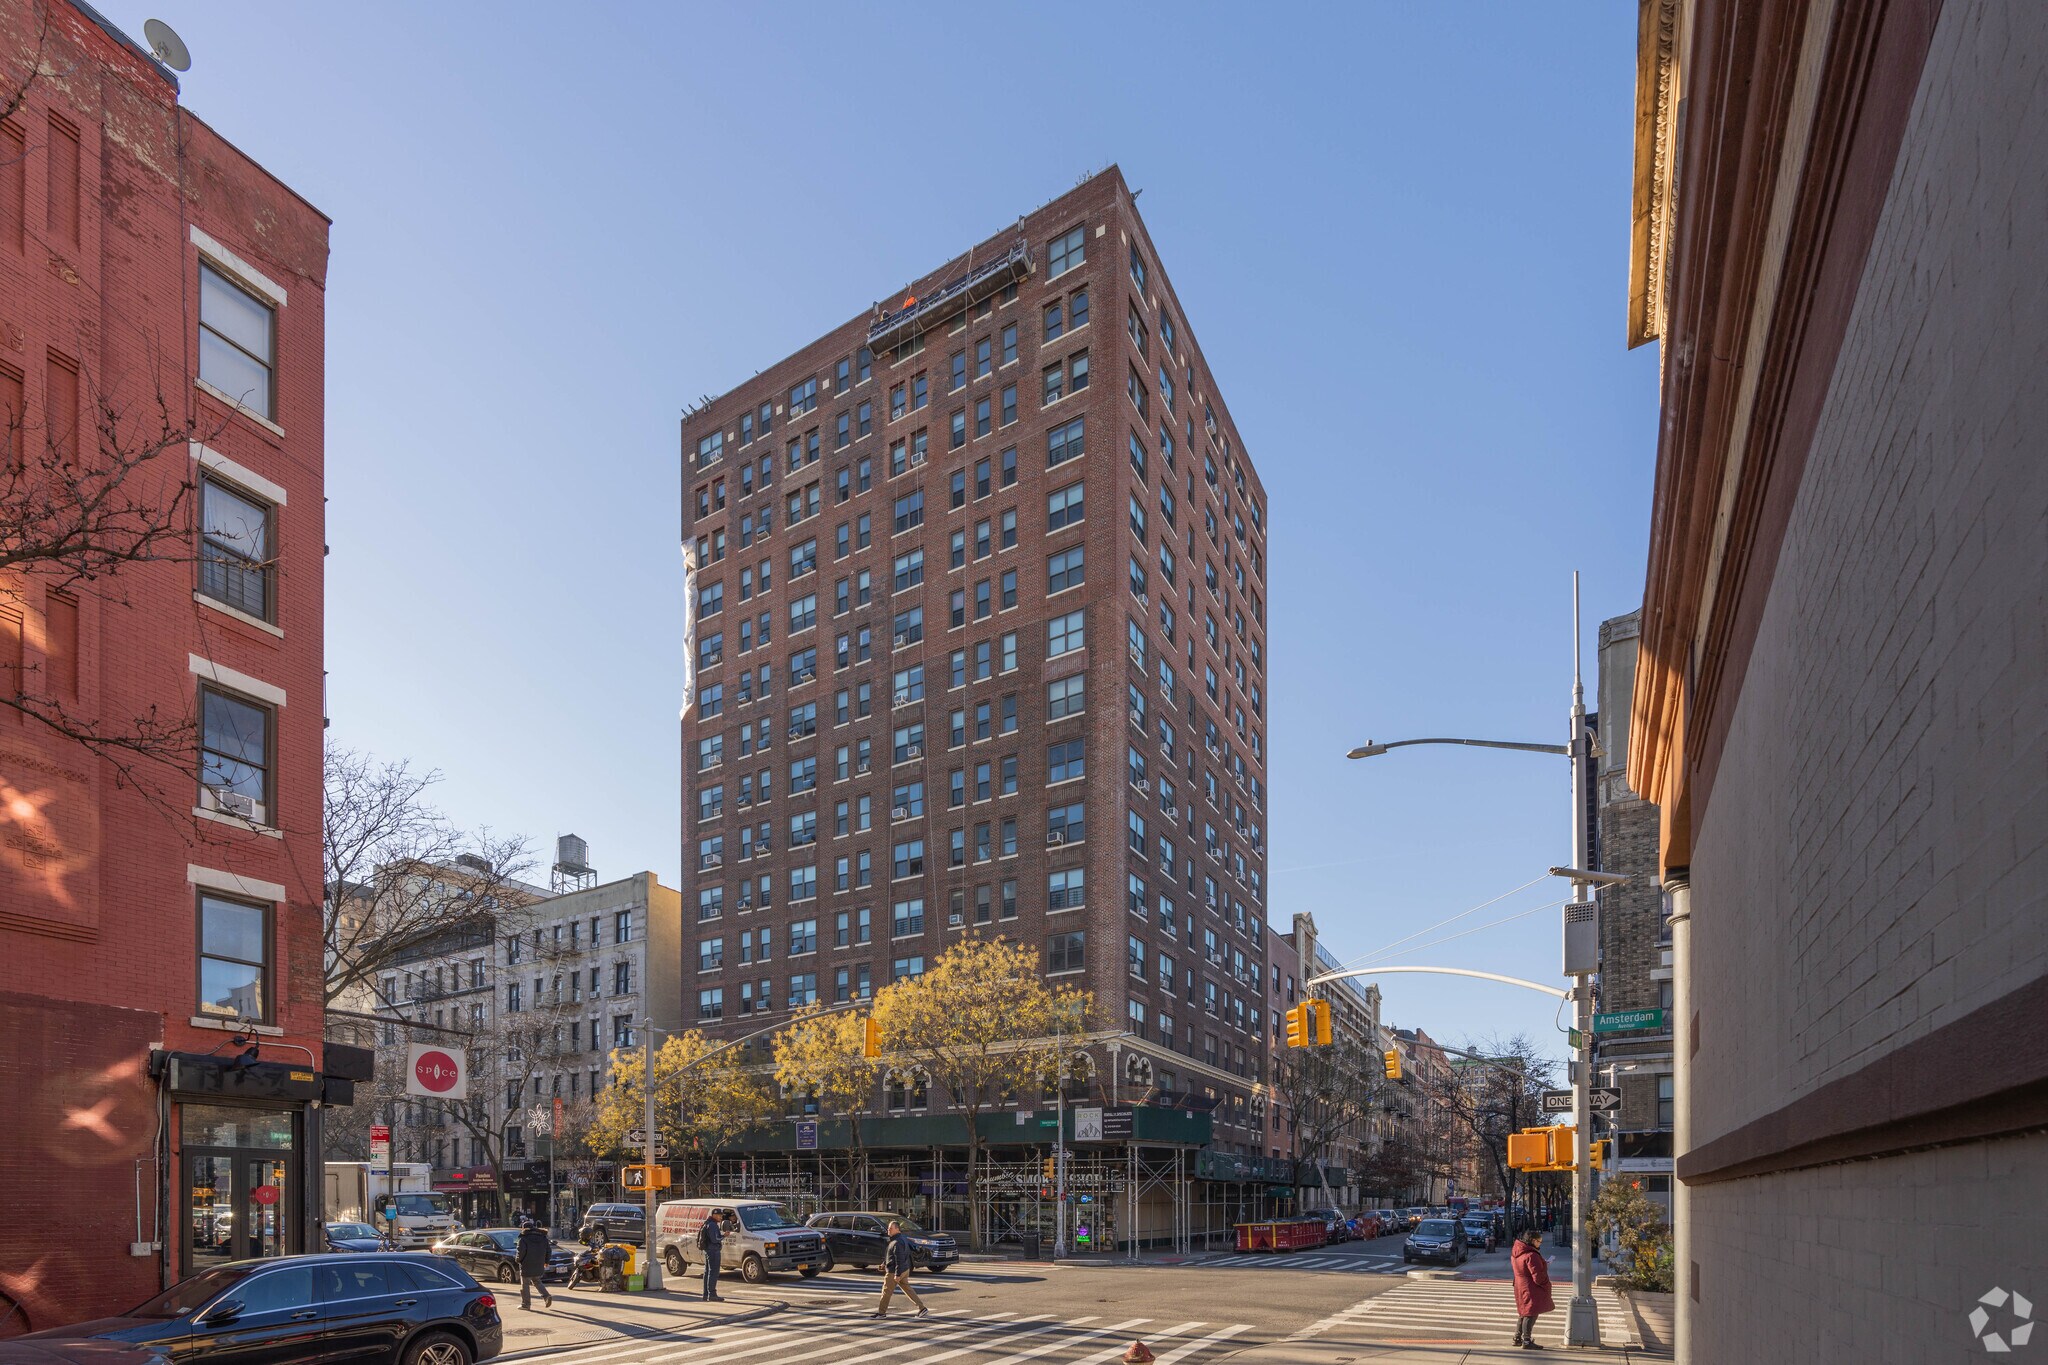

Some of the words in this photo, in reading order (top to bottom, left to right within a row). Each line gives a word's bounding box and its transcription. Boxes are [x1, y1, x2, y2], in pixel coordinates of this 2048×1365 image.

[1600, 1012, 1654, 1025] Amsterdam
[417, 1064, 456, 1080] spice
[1549, 1096, 1572, 1106] ONE
